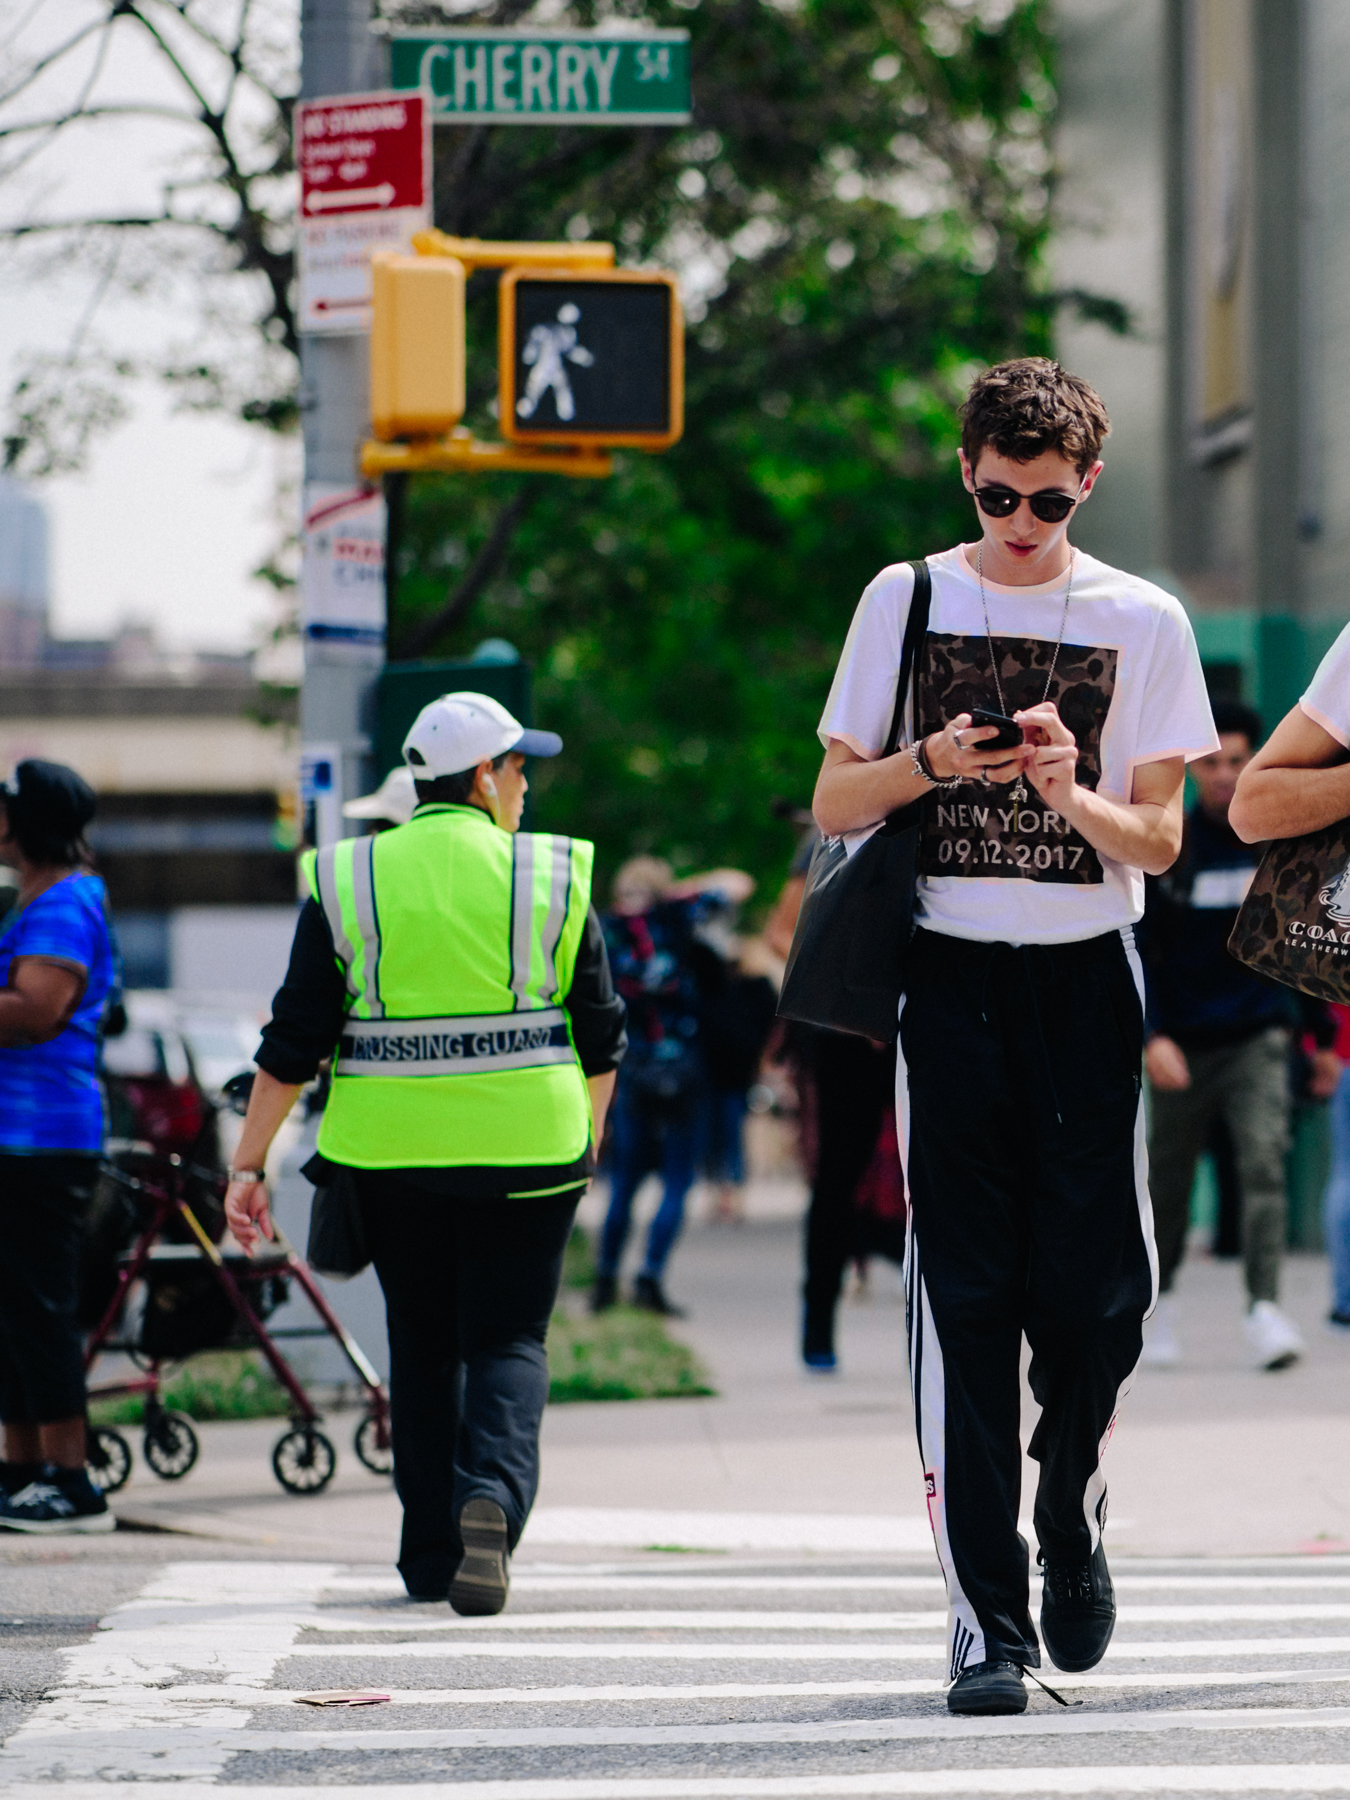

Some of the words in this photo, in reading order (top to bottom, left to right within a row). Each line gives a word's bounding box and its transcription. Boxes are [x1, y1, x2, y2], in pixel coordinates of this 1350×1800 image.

[419, 44, 620, 112] CHERRY
[937, 804, 989, 829] NEW
[938, 838, 1084, 870] 09.12.2017
